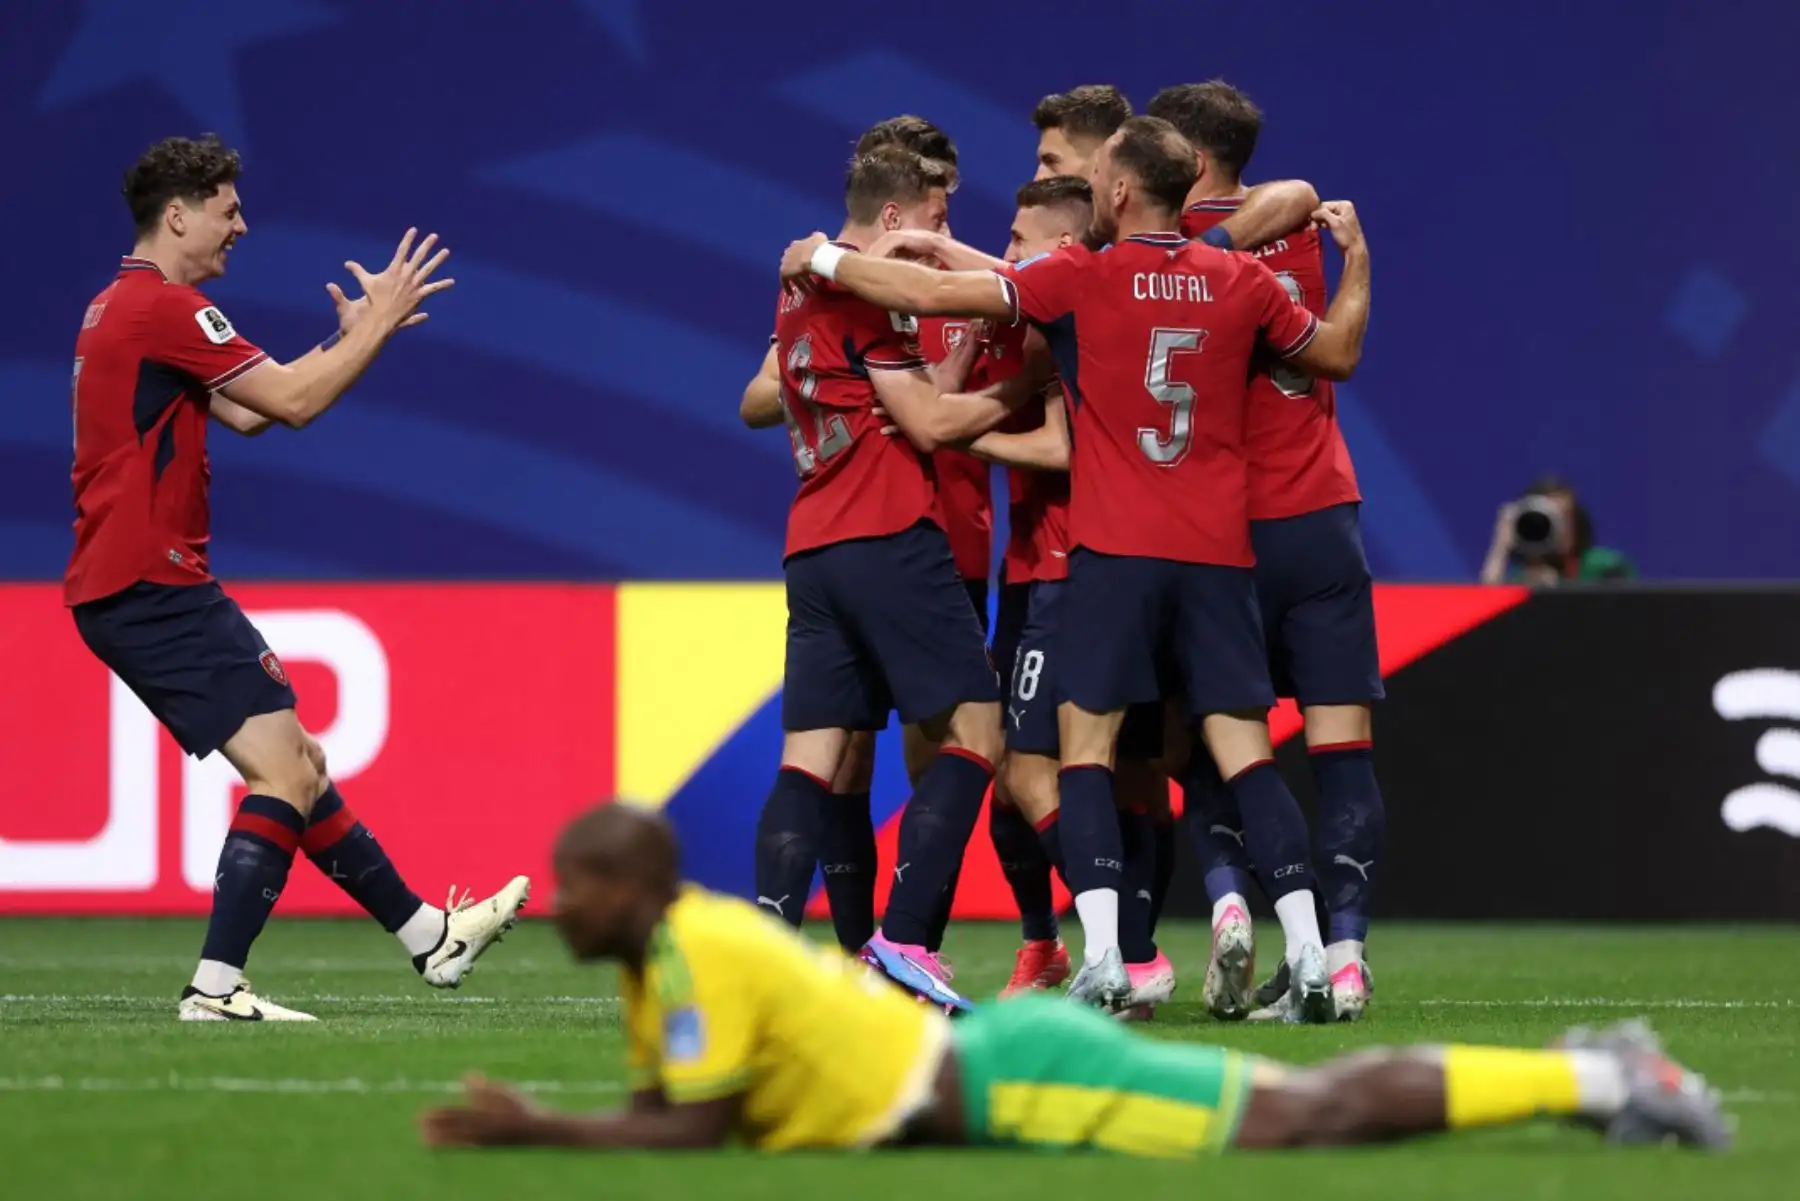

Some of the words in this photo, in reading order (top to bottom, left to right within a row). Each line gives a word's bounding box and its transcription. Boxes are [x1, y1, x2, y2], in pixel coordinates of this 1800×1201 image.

[1133, 272, 1214, 302] COUFAL
[1137, 327, 1209, 468] 5
[1273, 862, 1304, 879] CZE
